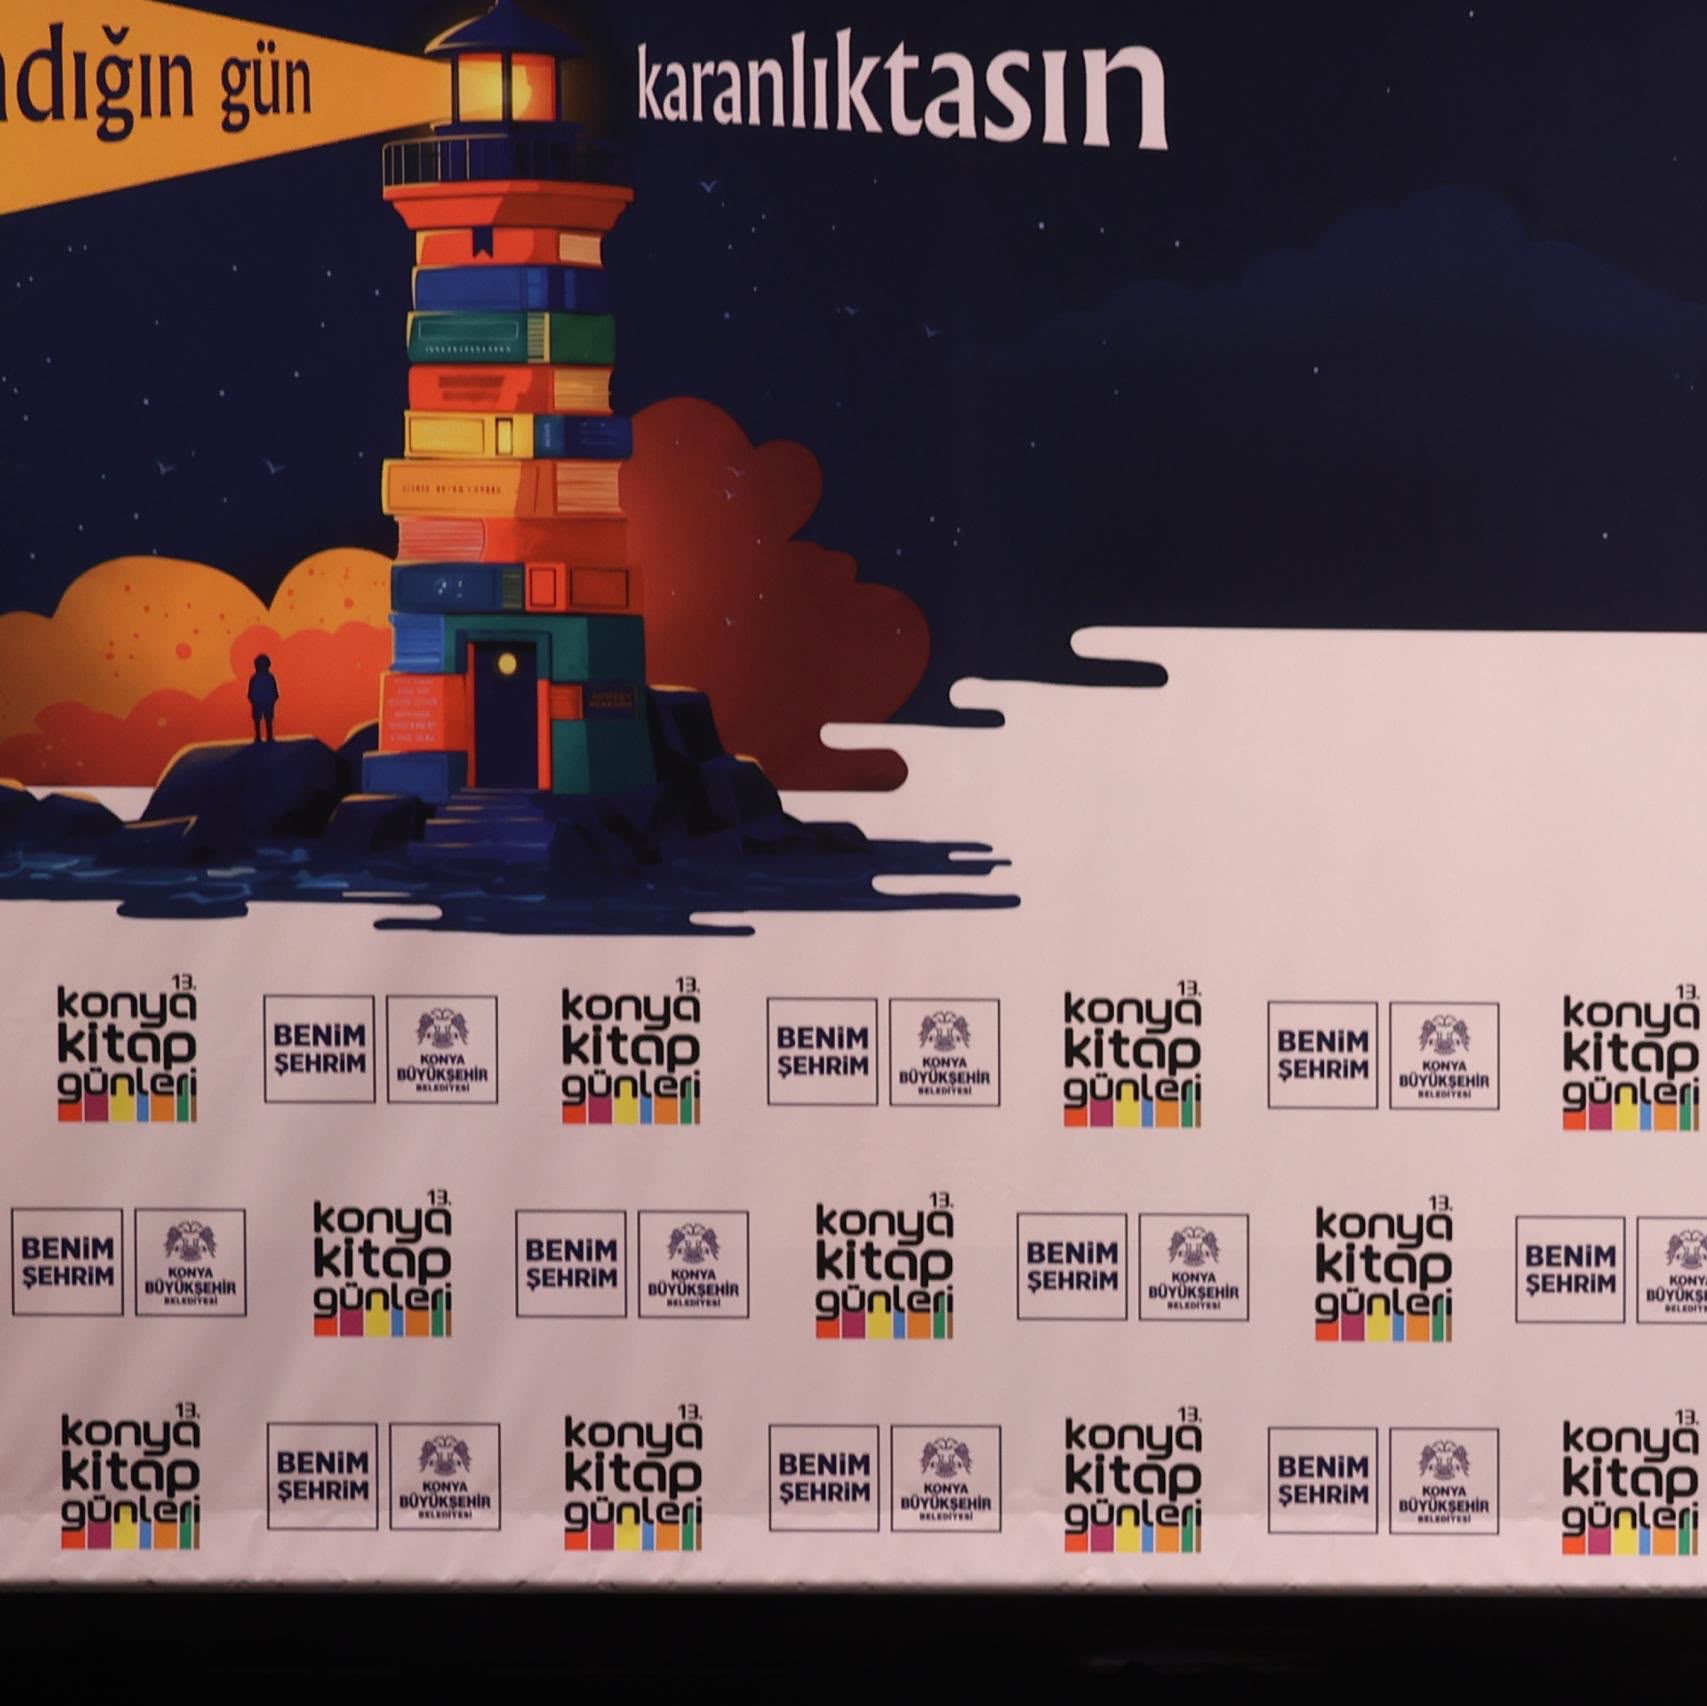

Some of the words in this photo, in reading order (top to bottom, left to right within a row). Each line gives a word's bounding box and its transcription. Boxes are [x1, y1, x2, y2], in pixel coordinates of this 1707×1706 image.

[0, 22, 193, 142] dığın
[221, 39, 311, 133] gün
[638, 27, 1169, 150] karanlıktasın
[57, 985, 197, 1028] konya
[562, 988, 700, 1030] konya
[1063, 991, 1201, 1033] konya
[58, 1022, 196, 1070] kitap
[420, 1054, 465, 1065] KONYA
[562, 1024, 700, 1072] kitap
[923, 1056, 967, 1067] KONYA
[1063, 1027, 1201, 1075] kitap
[57, 1067, 197, 1104] günleri
[397, 1066, 488, 1082] BÜYÜKŞEHİR
[562, 1069, 700, 1105] günleri
[900, 1068, 990, 1084] BÜYÜKŞEHİR
[1063, 1072, 1201, 1108] günleri
[313, 1201, 451, 1243] konya
[1315, 1207, 1452, 1249] konya
[168, 1267, 213, 1278] KONYA
[313, 1237, 451, 1285] kitap
[1172, 1271, 1216, 1282] KONYA
[1315, 1243, 1452, 1290] kitap
[145, 1279, 236, 1295] BÜYÜKŞEHİR
[313, 1282, 451, 1318] günleri
[1149, 1283, 1239, 1299] BÜYÜKŞEHİR
[1315, 1287, 1452, 1323] günleri
[564, 1415, 702, 1457] konya
[1562, 1421, 1699, 1463] konya
[423, 1481, 468, 1492] KONYA
[564, 1451, 702, 1499] kitap
[1423, 1485, 1467, 1496] KONYA
[1562, 1457, 1699, 1504] kitap
[400, 1493, 492, 1509] BÜYÜKŞEHİR
[564, 1496, 702, 1532] günleri
[1400, 1497, 1490, 1513] BÜYÜKŞEHİR
[1562, 1501, 1699, 1537] günleri
